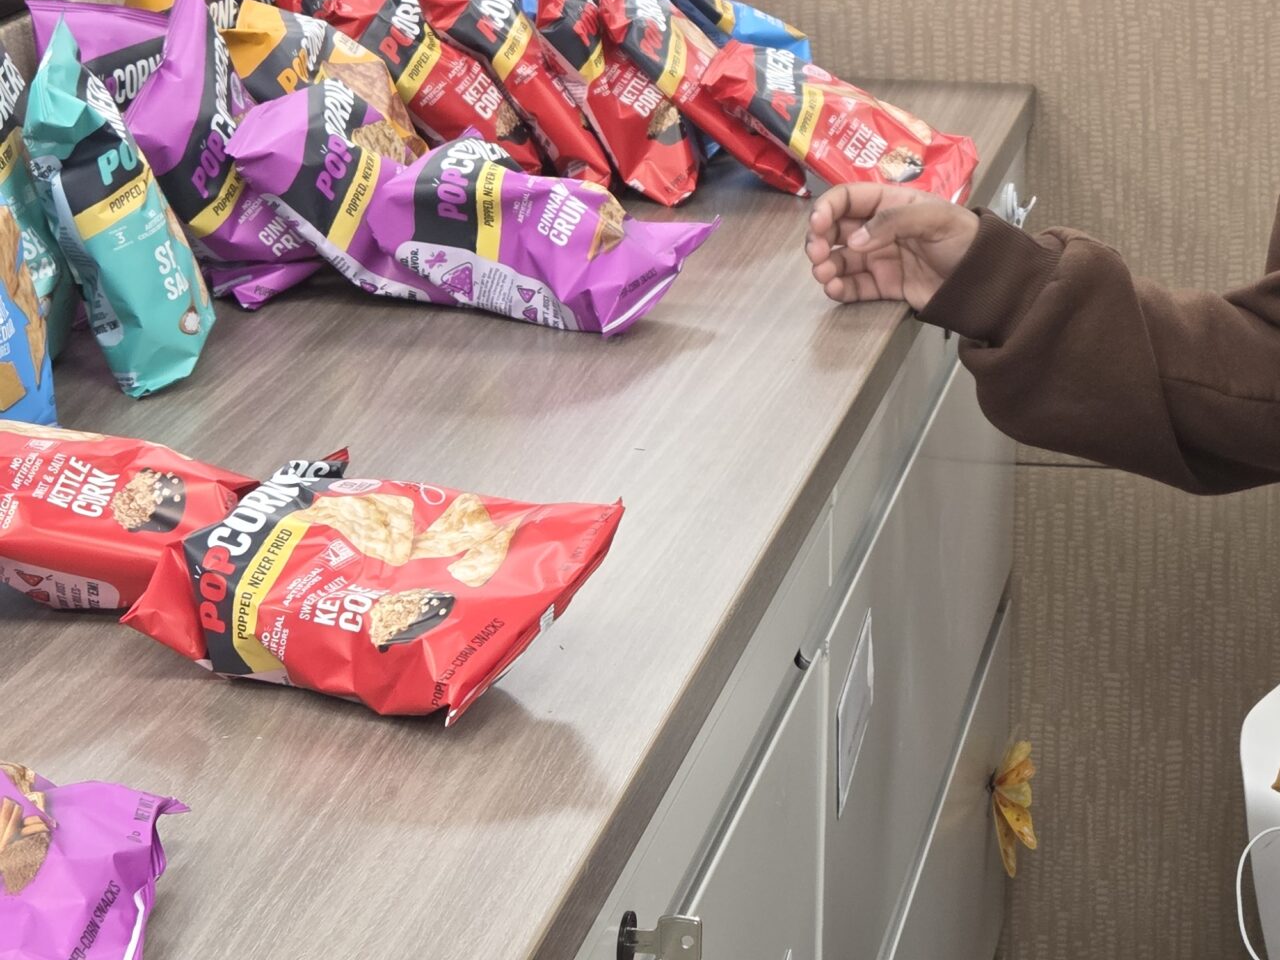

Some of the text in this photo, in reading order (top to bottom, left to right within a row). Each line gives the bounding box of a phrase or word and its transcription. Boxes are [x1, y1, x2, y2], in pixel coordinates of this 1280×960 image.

[474, 85, 504, 120] COR
[842, 122, 875, 161] KETTLE
[109, 183, 146, 213] POPPED,
[483, 170, 497, 198] NEVER
[115, 231, 126, 245] 3
[549, 195, 590, 247] CRUN
[10, 456, 23, 471] NO
[24, 458, 44, 487] FLAVORS
[43, 472, 55, 484] &
[46, 456, 93, 510] KETTLE
[71, 467, 121, 518] CORN
[236, 527, 294, 640] POPPED, NEVER FRIED
[283, 566, 325, 607] ARTIFICIAL
[324, 576, 350, 594] SALTY
[471, 617, 506, 653] SNACKS
[93, 878, 122, 924] SNACKS
